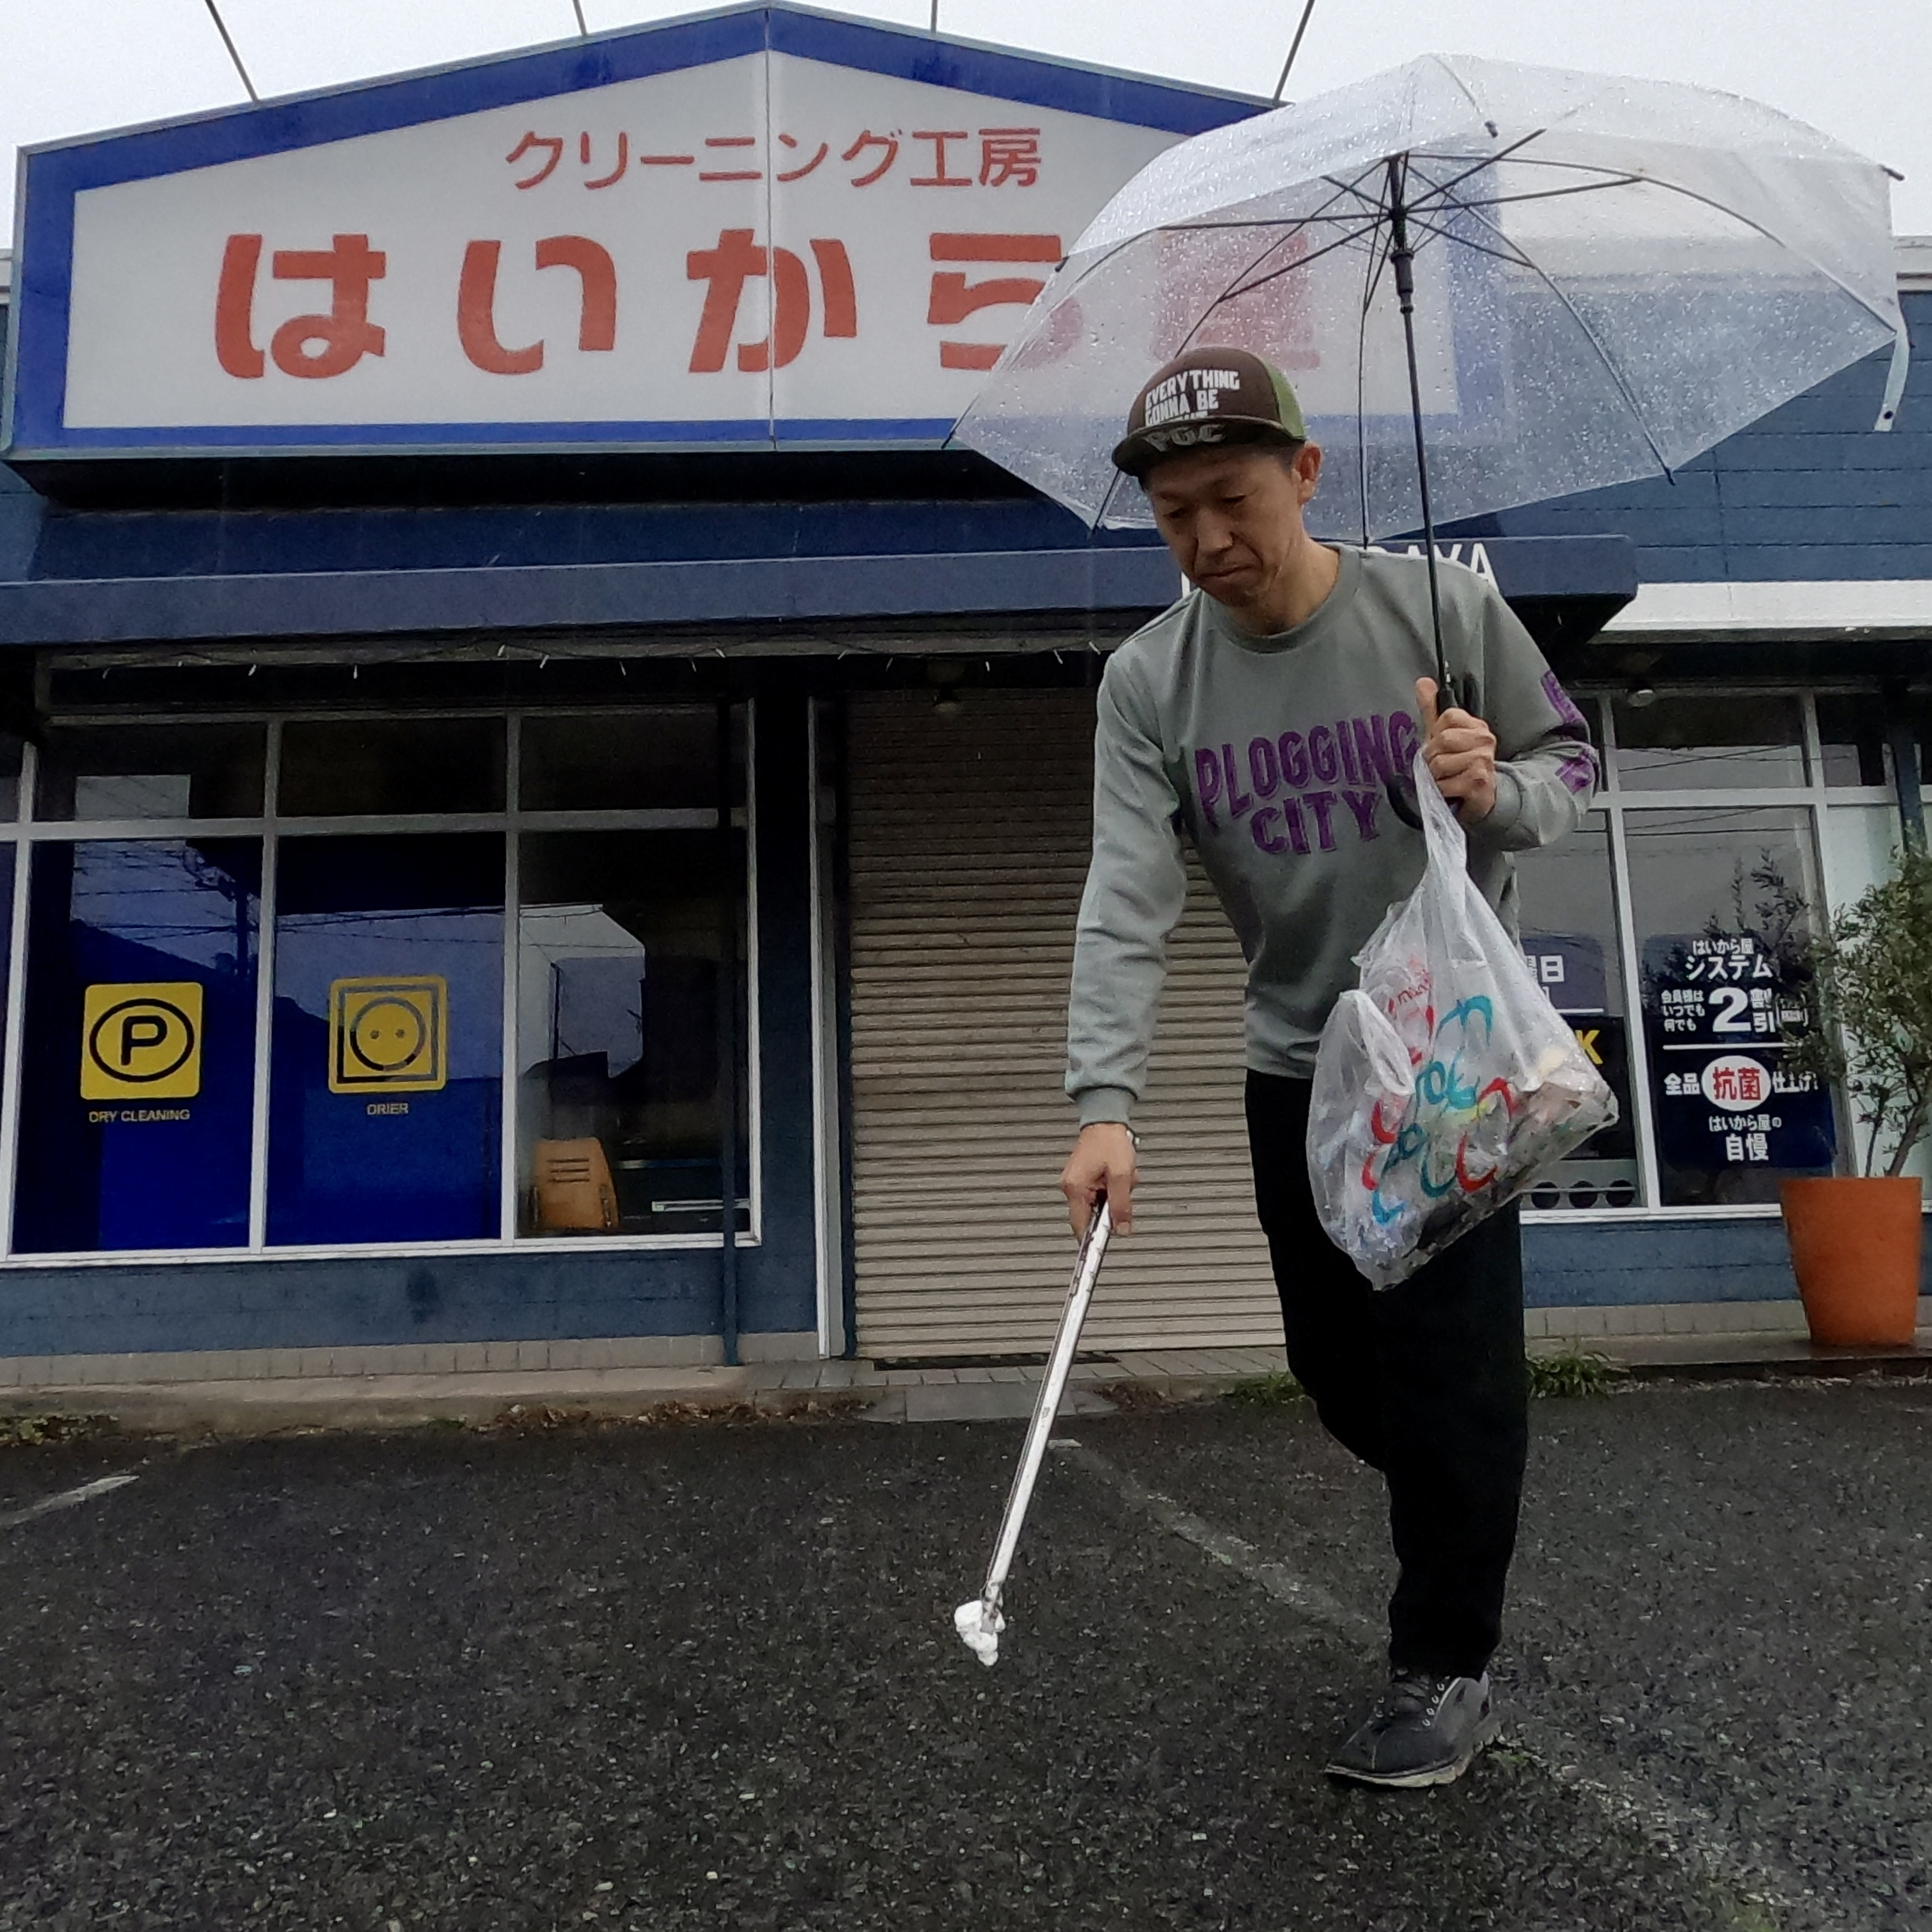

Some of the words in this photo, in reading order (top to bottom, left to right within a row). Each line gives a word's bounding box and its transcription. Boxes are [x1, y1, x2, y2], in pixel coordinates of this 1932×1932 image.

[506, 128, 1041, 190] クリーニング工房
[1145, 369, 1240, 410] EVERYTHING
[1145, 392, 1190, 427] GONNA
[1196, 389, 1219, 411] BE
[1194, 710, 1421, 829] PLOGGING
[1249, 791, 1382, 855] CITY
[1692, 937, 1755, 956] はいから屋
[1685, 954, 1773, 981] システム
[1661, 1003, 1706, 1017] いつでも
[1663, 1018, 1697, 1032] 何でも
[1663, 1072, 1702, 1096] 全品
[1712, 1066, 1762, 1101] 抗菌
[88, 1111, 118, 1123] DRY
[120, 1109, 190, 1122] CLEANING
[367, 1103, 409, 1115] DRIER
[1725, 1132, 1770, 1162] 自慢
